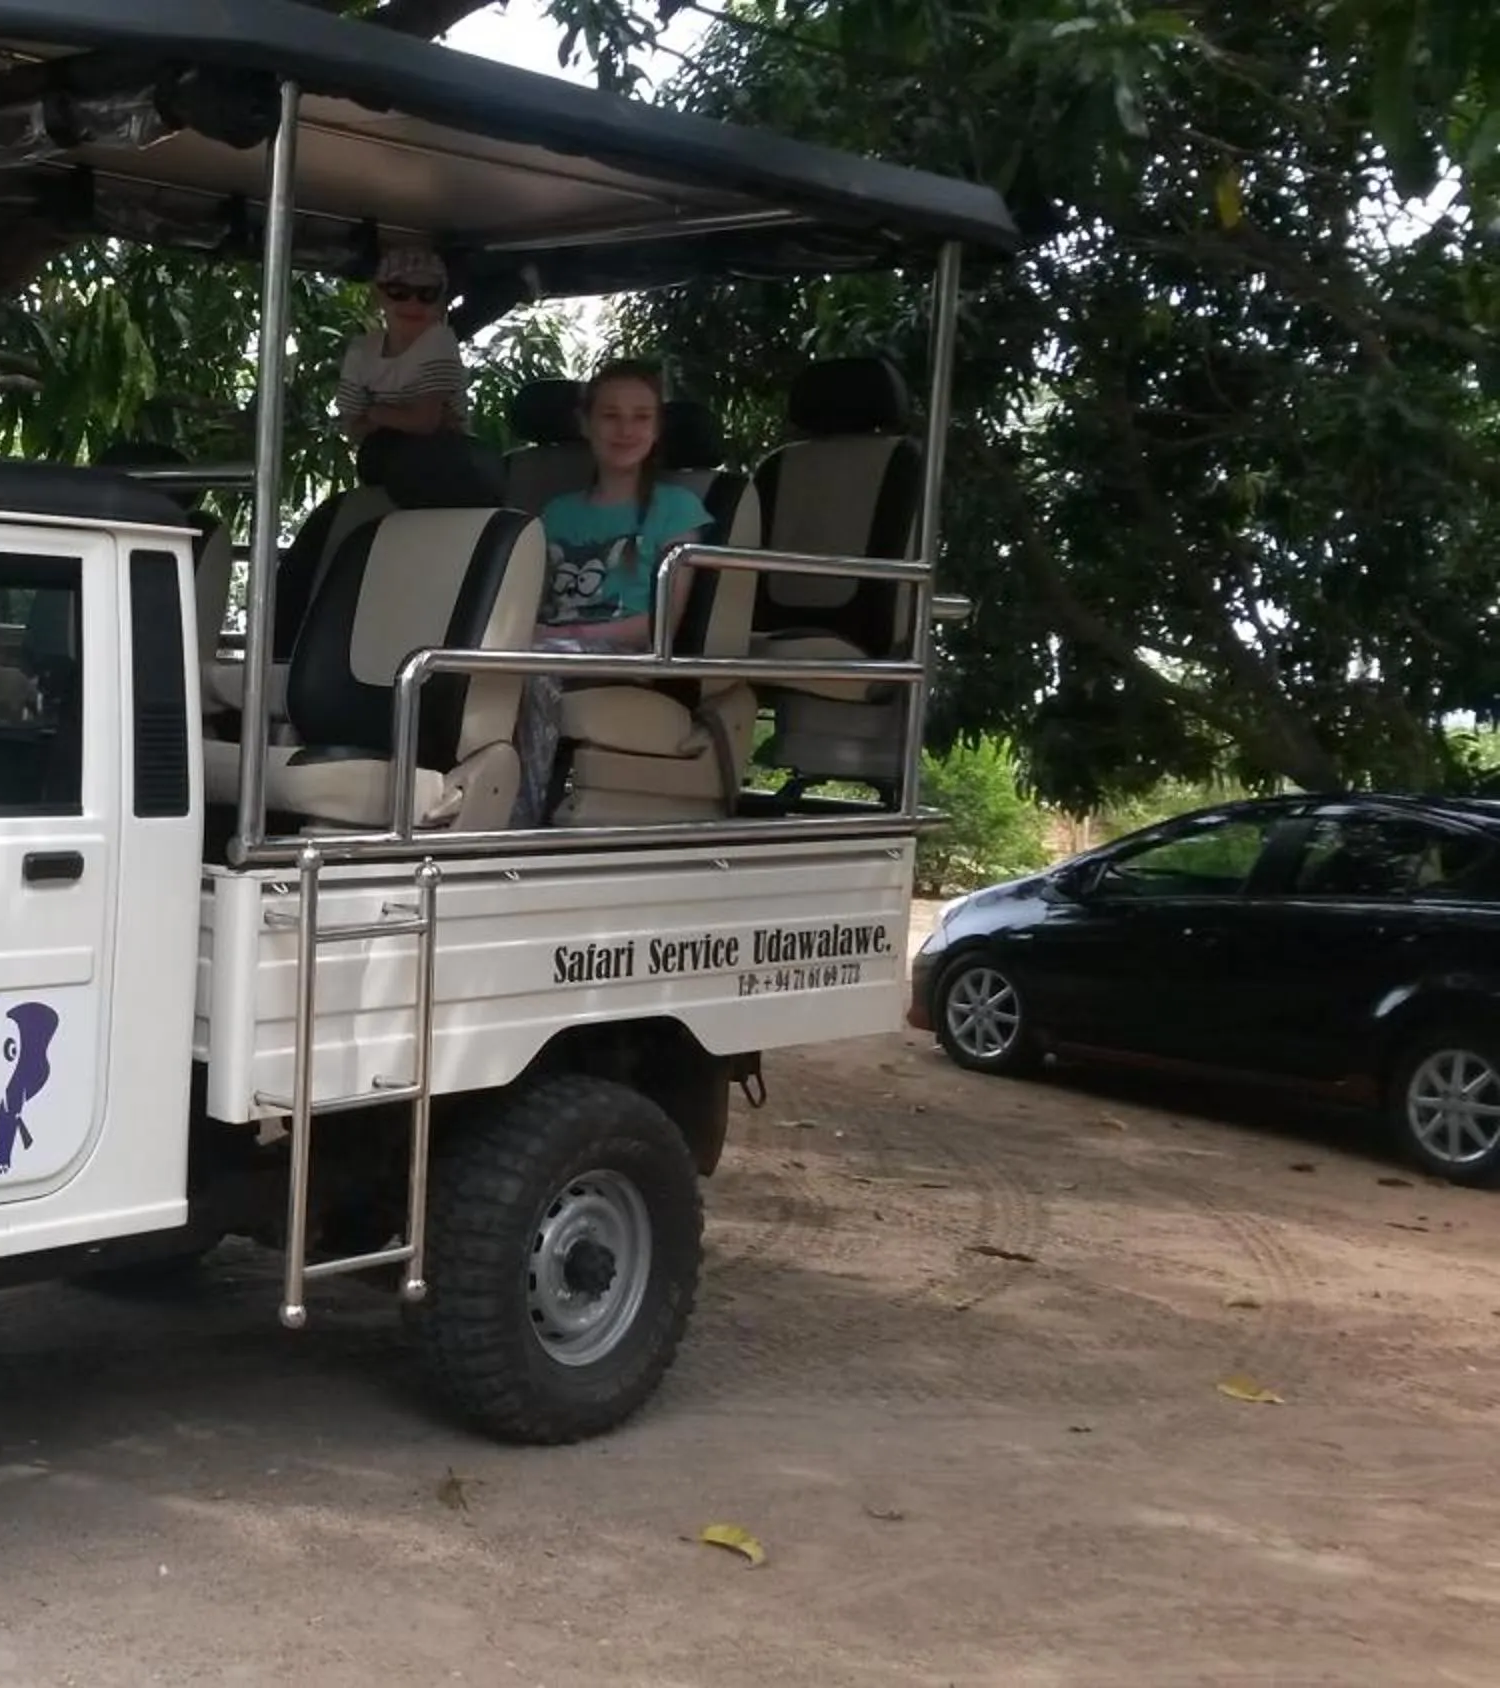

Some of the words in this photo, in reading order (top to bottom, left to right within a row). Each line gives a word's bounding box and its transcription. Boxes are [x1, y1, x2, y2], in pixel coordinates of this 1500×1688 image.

[553, 940, 635, 984] Safari
[649, 934, 739, 975] Service
[753, 924, 892, 964] Udawalawe.
